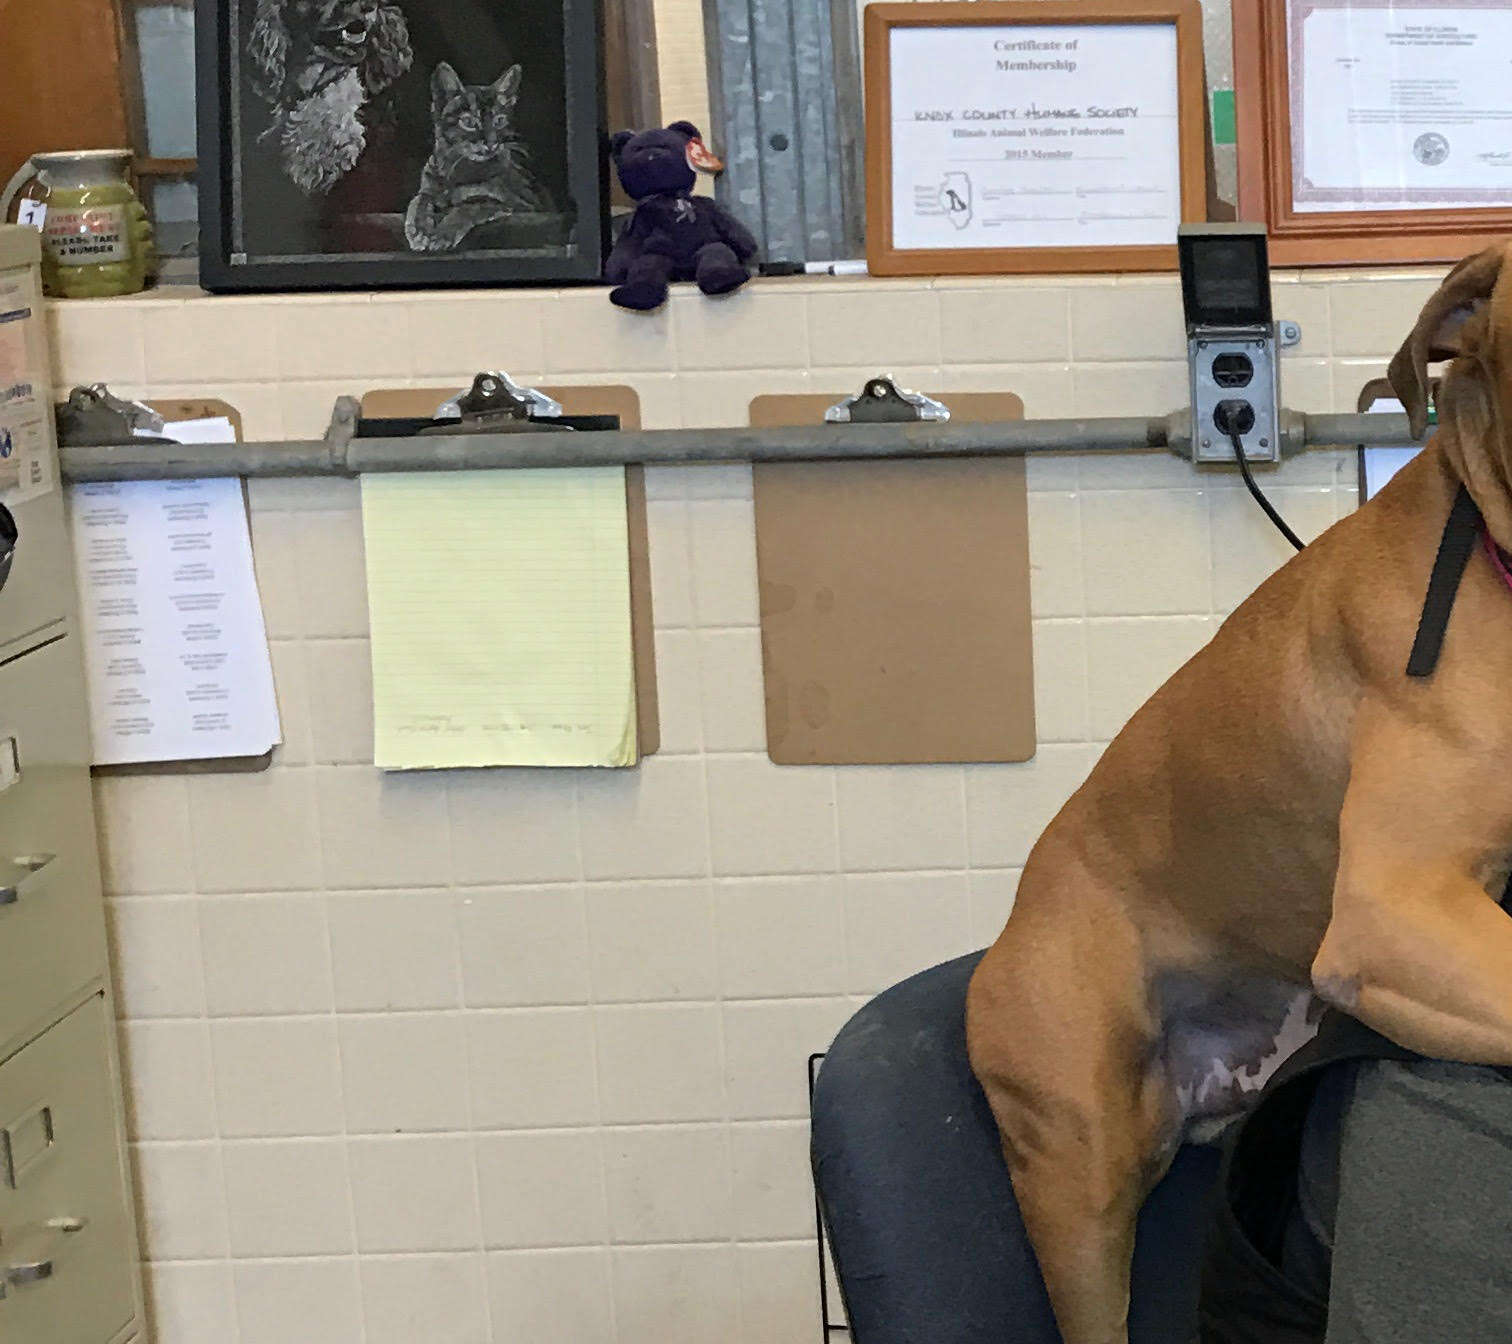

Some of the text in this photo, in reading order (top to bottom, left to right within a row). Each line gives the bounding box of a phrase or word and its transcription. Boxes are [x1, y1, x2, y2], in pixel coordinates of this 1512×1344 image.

[994, 39, 1079, 52] Certificate of
[996, 60, 1077, 73] Membership
[914, 111, 953, 121] KNOX
[962, 110, 1016, 120] COUNTY
[1087, 106, 1139, 119] SOCIETY
[26, 211, 34, 224] 1
[69, 244, 114, 255] NUMBER
